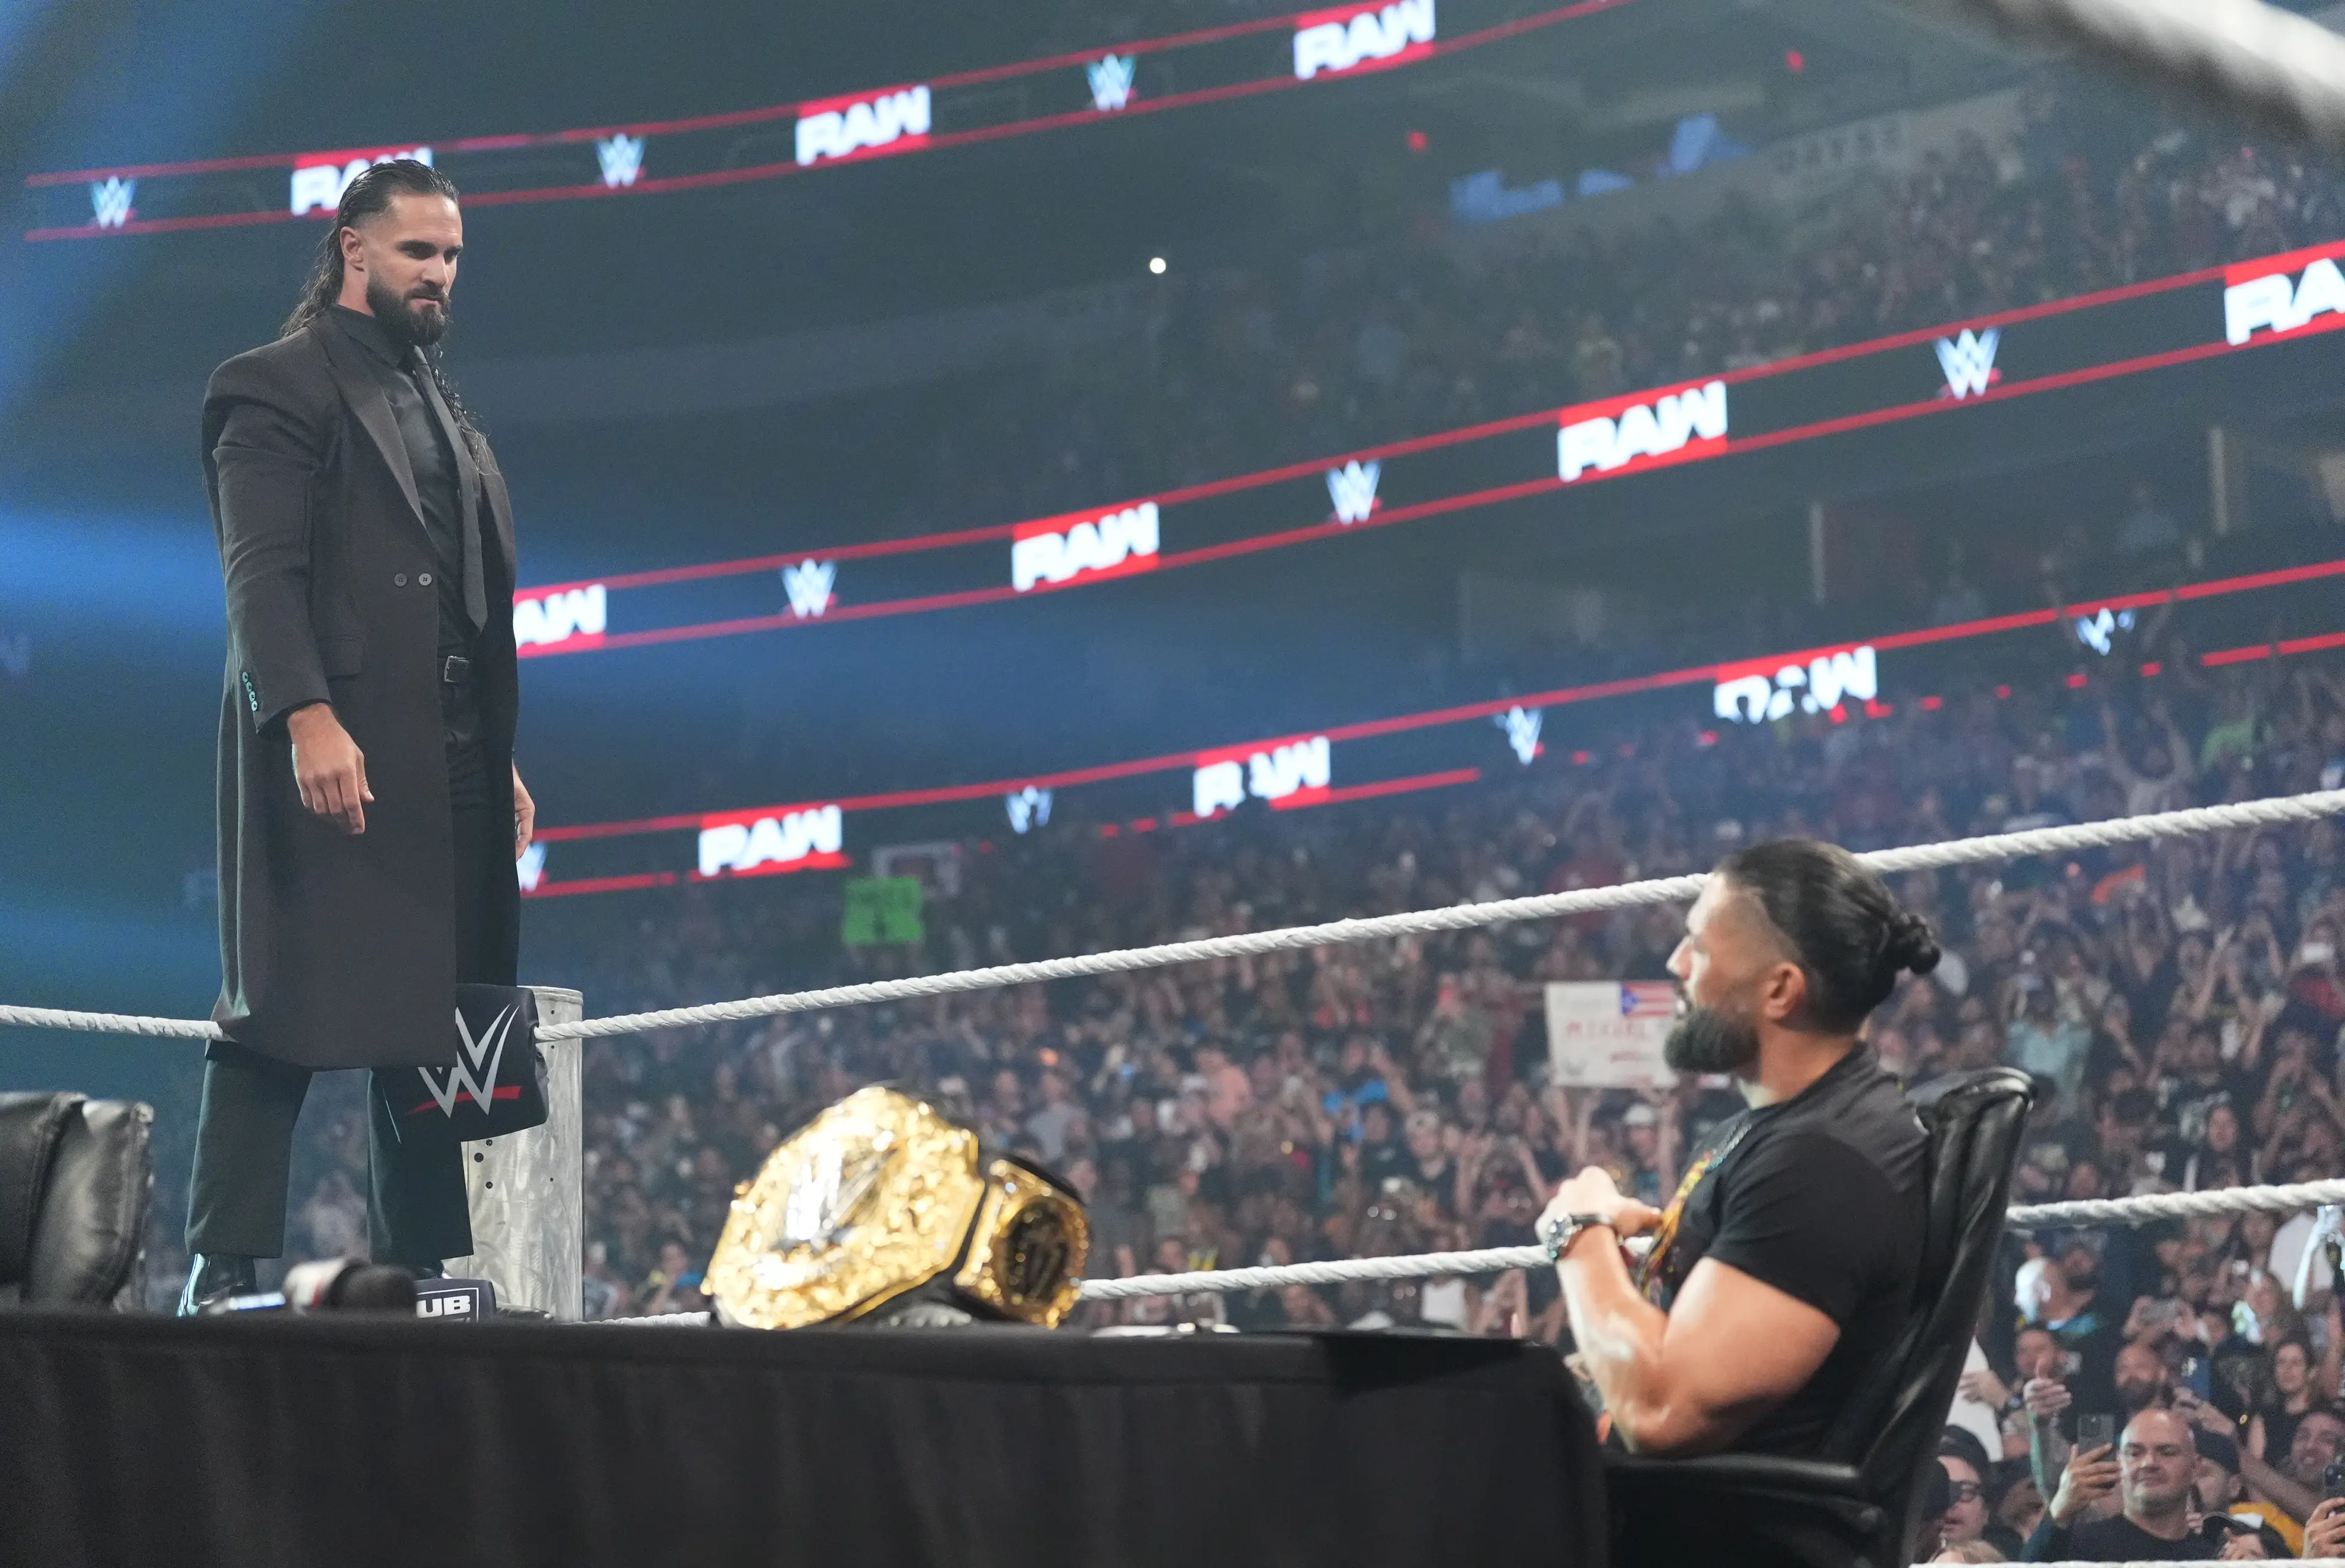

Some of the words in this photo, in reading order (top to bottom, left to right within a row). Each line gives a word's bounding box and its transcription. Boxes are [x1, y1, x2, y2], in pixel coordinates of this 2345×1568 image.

[1293, 0, 1436, 80] RAW
[794, 84, 931, 166] RAW
[2223, 258, 2345, 346] RA
[1557, 380, 1729, 482] RAW
[1011, 501, 1160, 592] RAW
[513, 583, 608, 650] AW
[698, 804, 843, 877] RAW
